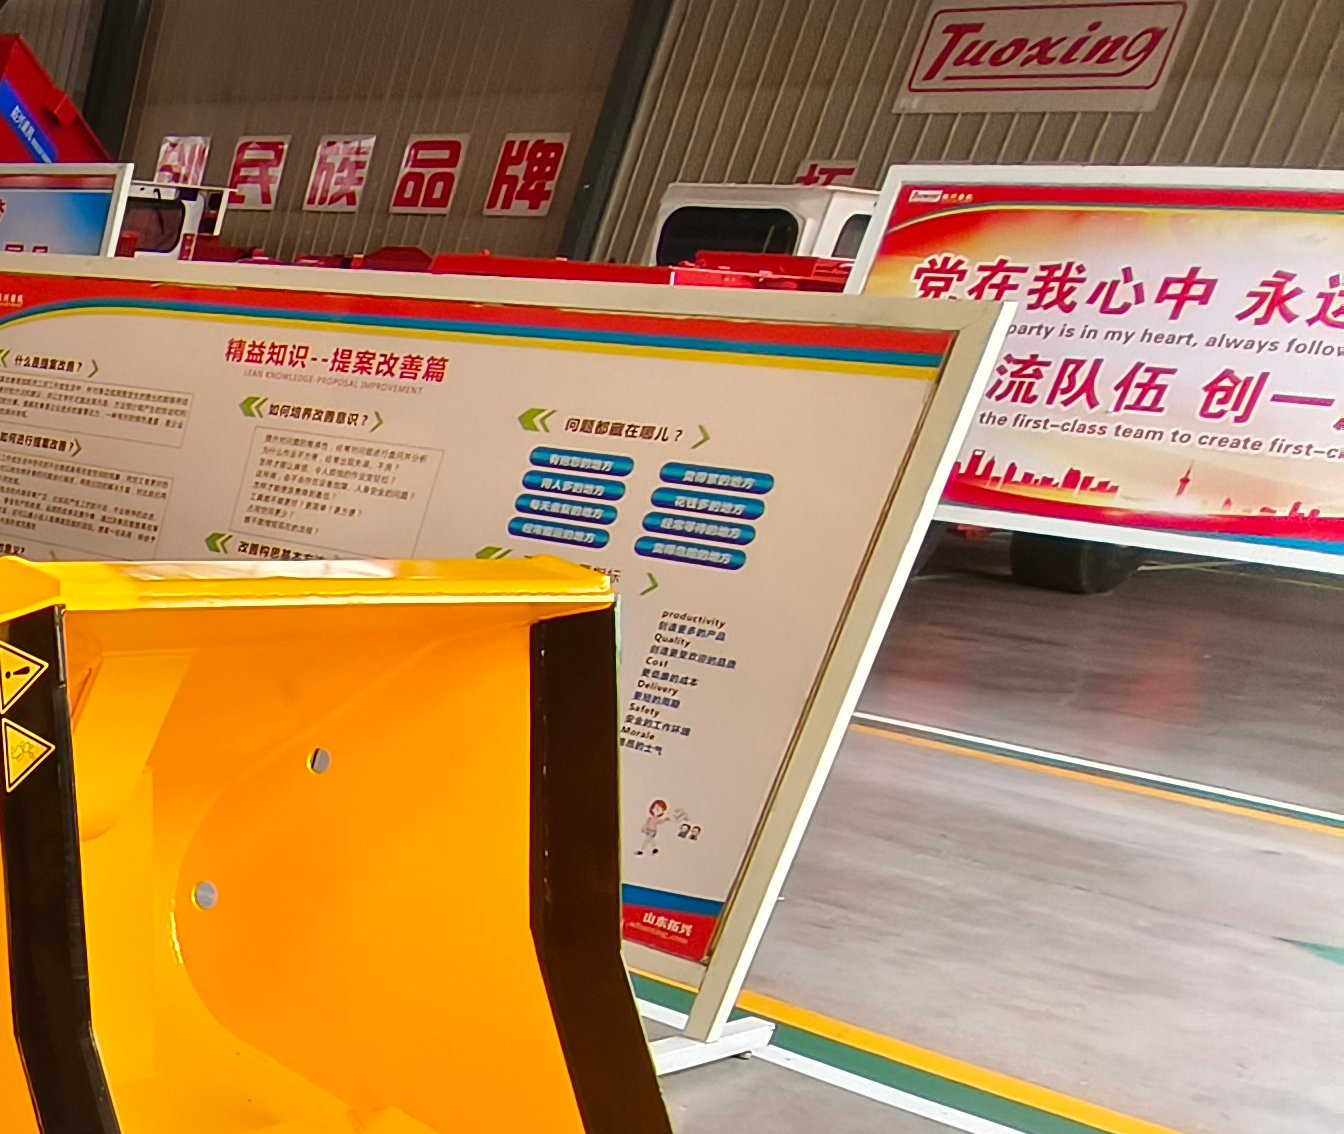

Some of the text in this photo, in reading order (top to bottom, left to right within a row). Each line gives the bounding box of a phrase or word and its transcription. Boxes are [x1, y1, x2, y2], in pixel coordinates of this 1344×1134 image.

[922, 20, 1169, 82] Tuoxing
[913, 255, 1218, 320] 党在我心中
[1058, 323, 1075, 338] is
[1080, 324, 1098, 340] in
[1104, 329, 1135, 345] my
[1140, 328, 1197, 349] heart,
[1205, 333, 1280, 354] always
[225, 338, 449, 382] 精益知识--提案改善篇
[985, 353, 1344, 431] 流队伍 创一
[978, 411, 1007, 427] the
[1114, 425, 1164, 442] team
[1171, 429, 1192, 444] to
[1197, 434, 1263, 452] create
[662, 610, 726, 629] productivity
[654, 633, 691, 648] Quality
[645, 656, 669, 669] Cost
[637, 679, 679, 697] Delivery
[628, 702, 660, 718] Safety
[620, 726, 655, 740] Morale
